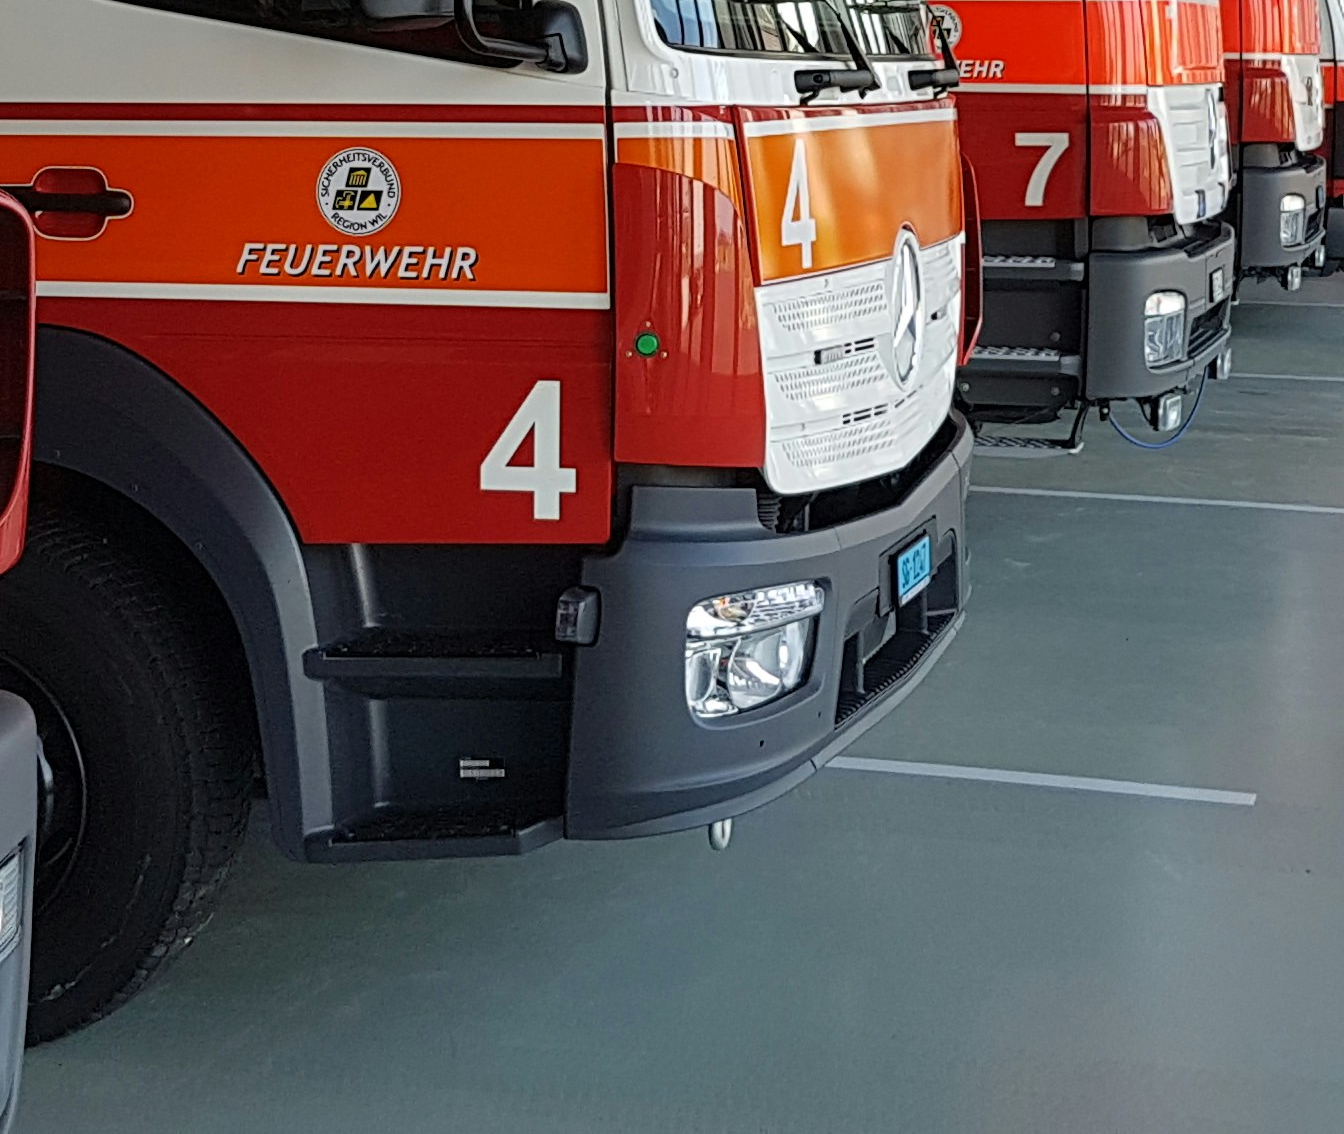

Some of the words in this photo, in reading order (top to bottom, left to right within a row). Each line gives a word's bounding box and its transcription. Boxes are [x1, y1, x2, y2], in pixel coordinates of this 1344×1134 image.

[320, 152, 396, 199] SICHERHEITSVERBUND
[1014, 132, 1070, 208] 7
[330, 211, 368, 232] REGION
[368, 212, 388, 227] WIL
[781, 138, 817, 269] 4
[235, 242, 479, 281] FEUERWEHR
[479, 379, 577, 521] 4
